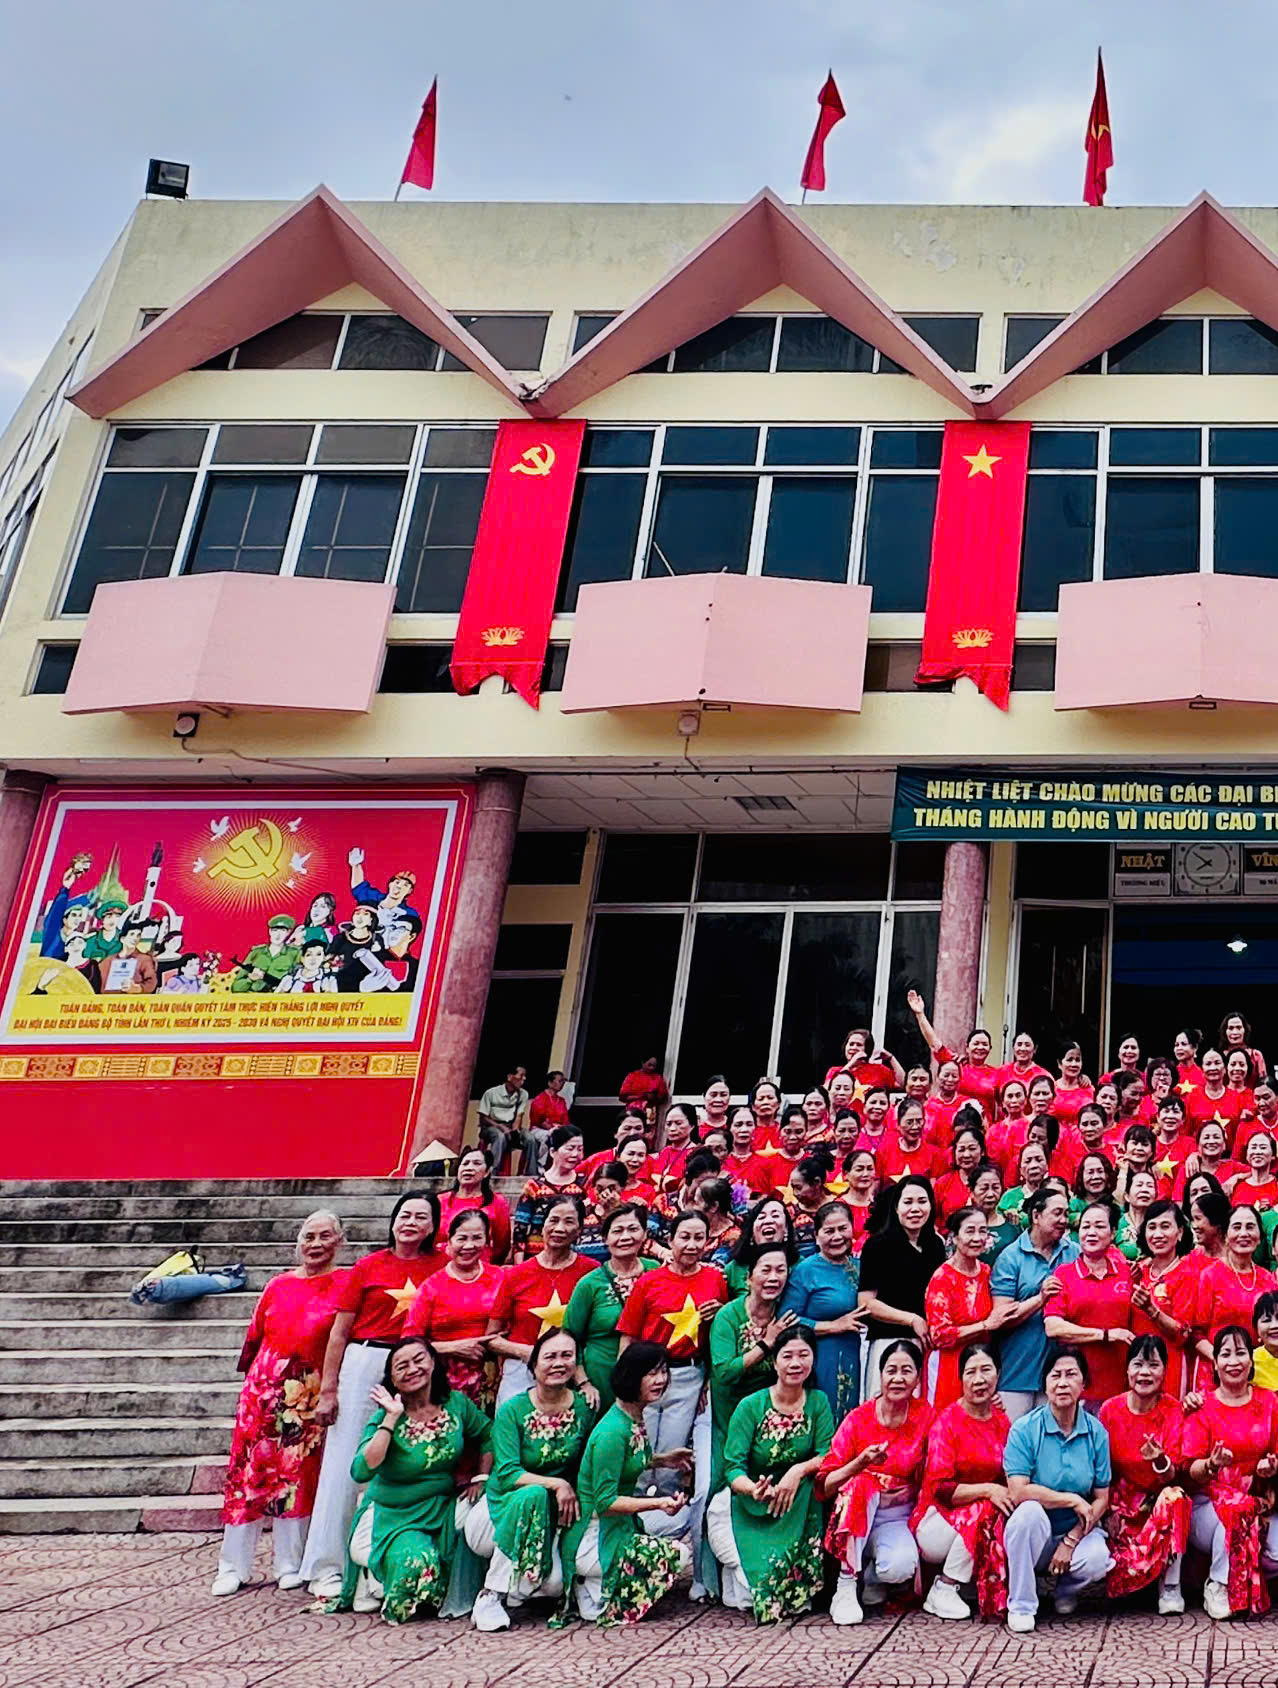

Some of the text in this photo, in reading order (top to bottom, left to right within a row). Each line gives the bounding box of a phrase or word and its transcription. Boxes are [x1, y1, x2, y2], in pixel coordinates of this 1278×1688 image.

[926, 779, 987, 803] NHIỆT
[992, 780, 1032, 803] LIỆT
[1039, 781, 1095, 801] CHÀO
[1103, 782, 1163, 802] MỪNG
[1170, 783, 1212, 803] CÁC
[1218, 785, 1252, 806] ĐẠI
[914, 806, 982, 827] THÁNG
[989, 807, 1045, 829] HÀNH
[1052, 807, 1110, 832] ĐỘNG
[1116, 808, 1137, 830] VÌ
[1144, 809, 1209, 830] NGƯỜI
[1215, 812, 1256, 831] CAO
[1120, 853, 1165, 870] NHẬT
